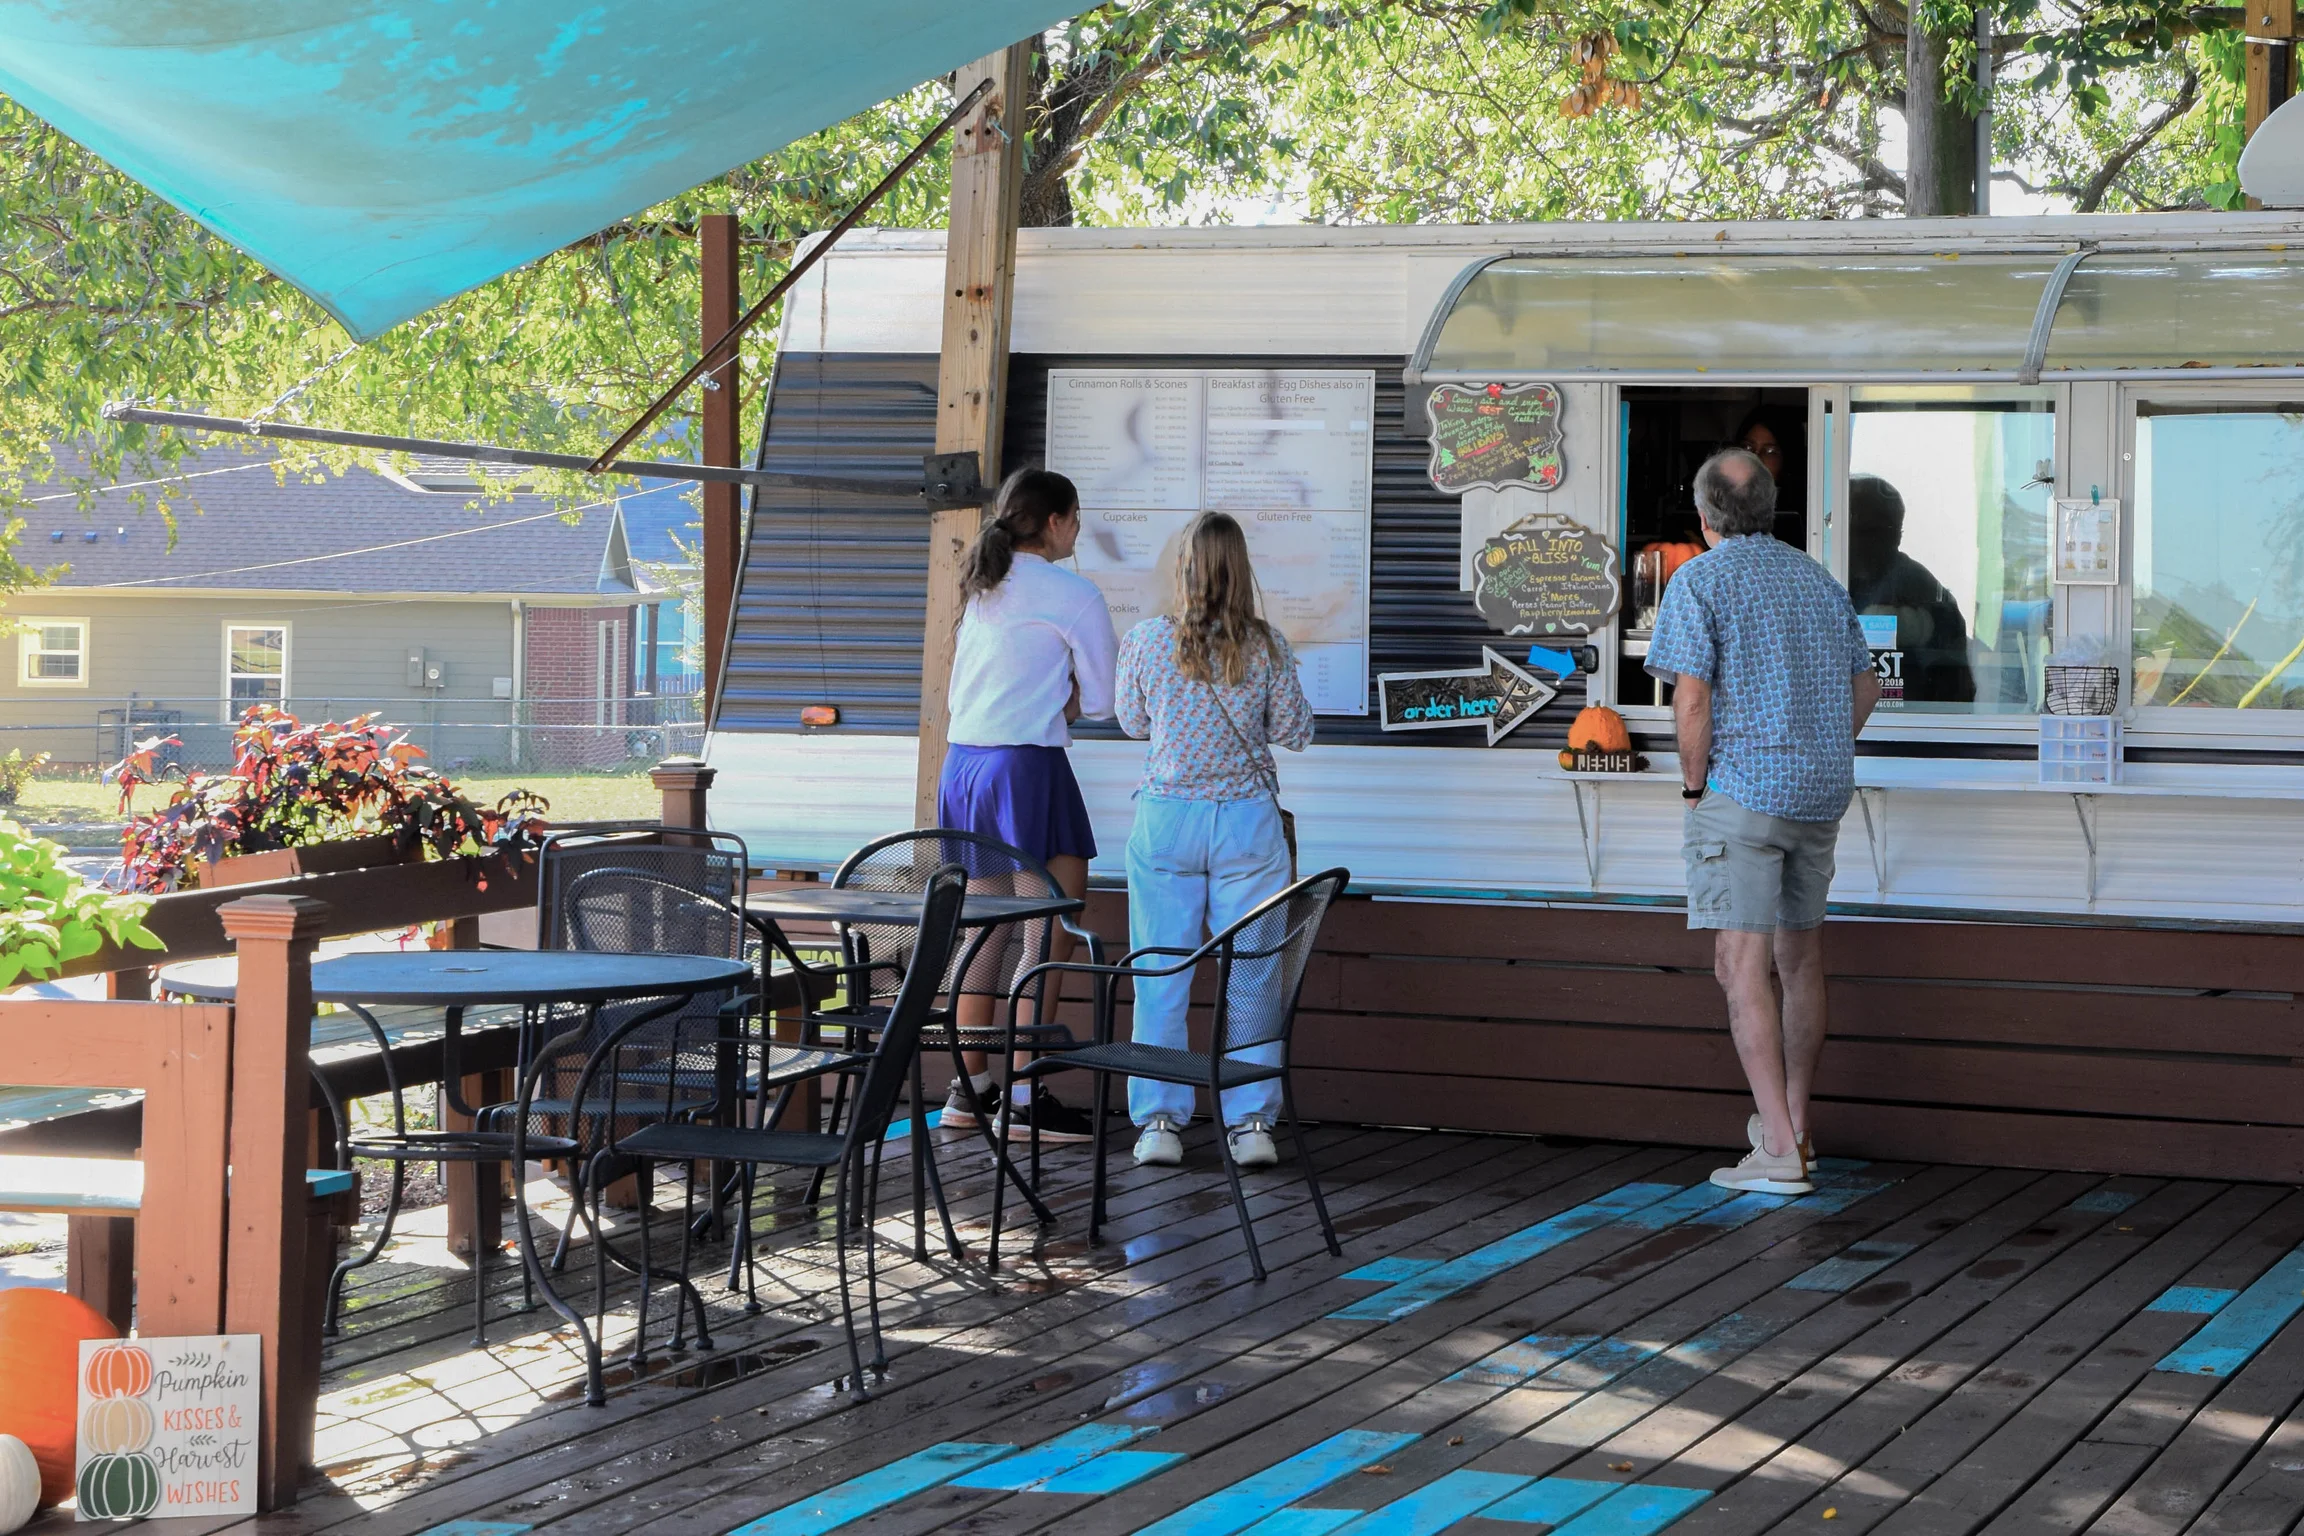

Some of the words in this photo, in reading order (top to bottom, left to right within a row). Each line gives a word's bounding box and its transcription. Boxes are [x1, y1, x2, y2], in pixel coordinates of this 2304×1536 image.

[1068, 379, 1118, 389] Cinnamon
[1120, 379, 1142, 389] Rolls
[1144, 379, 1152, 389] &
[1154, 379, 1188, 389] Scones
[1211, 379, 1255, 389] Breakfast
[1257, 379, 1275, 389] and
[1278, 380, 1297, 391] Egg
[1299, 380, 1331, 389] Dishes
[1333, 380, 1353, 389] also
[1355, 380, 1365, 389] in
[1259, 394, 1292, 404] Gluten
[1294, 394, 1316, 404] Free
[1499, 395, 1518, 406] and
[1478, 406, 1504, 416] BEST
[1439, 418, 1468, 431] Taking
[1102, 512, 1148, 522] Cupcakes
[1257, 512, 1289, 521] Gluten
[1291, 512, 1312, 521] Free
[1509, 539, 1540, 556] FALL
[1548, 539, 1583, 552] INTO
[1581, 556, 1607, 574] Yum!
[1529, 574, 1567, 584] Espresso
[1521, 583, 1548, 592] Carrot
[1541, 591, 1580, 601] S'Mores
[1106, 604, 1140, 614] ookies
[1540, 600, 1566, 611] Peanut
[1870, 652, 1904, 678] EST
[1404, 696, 1457, 719] order
[1459, 695, 1498, 716] here
[154, 1361, 248, 1401] Pumpkin
[164, 1406, 224, 1431] KISSES
[229, 1404, 242, 1428] &
[154, 1439, 251, 1474] Harvest
[167, 1480, 240, 1504] WISHES
